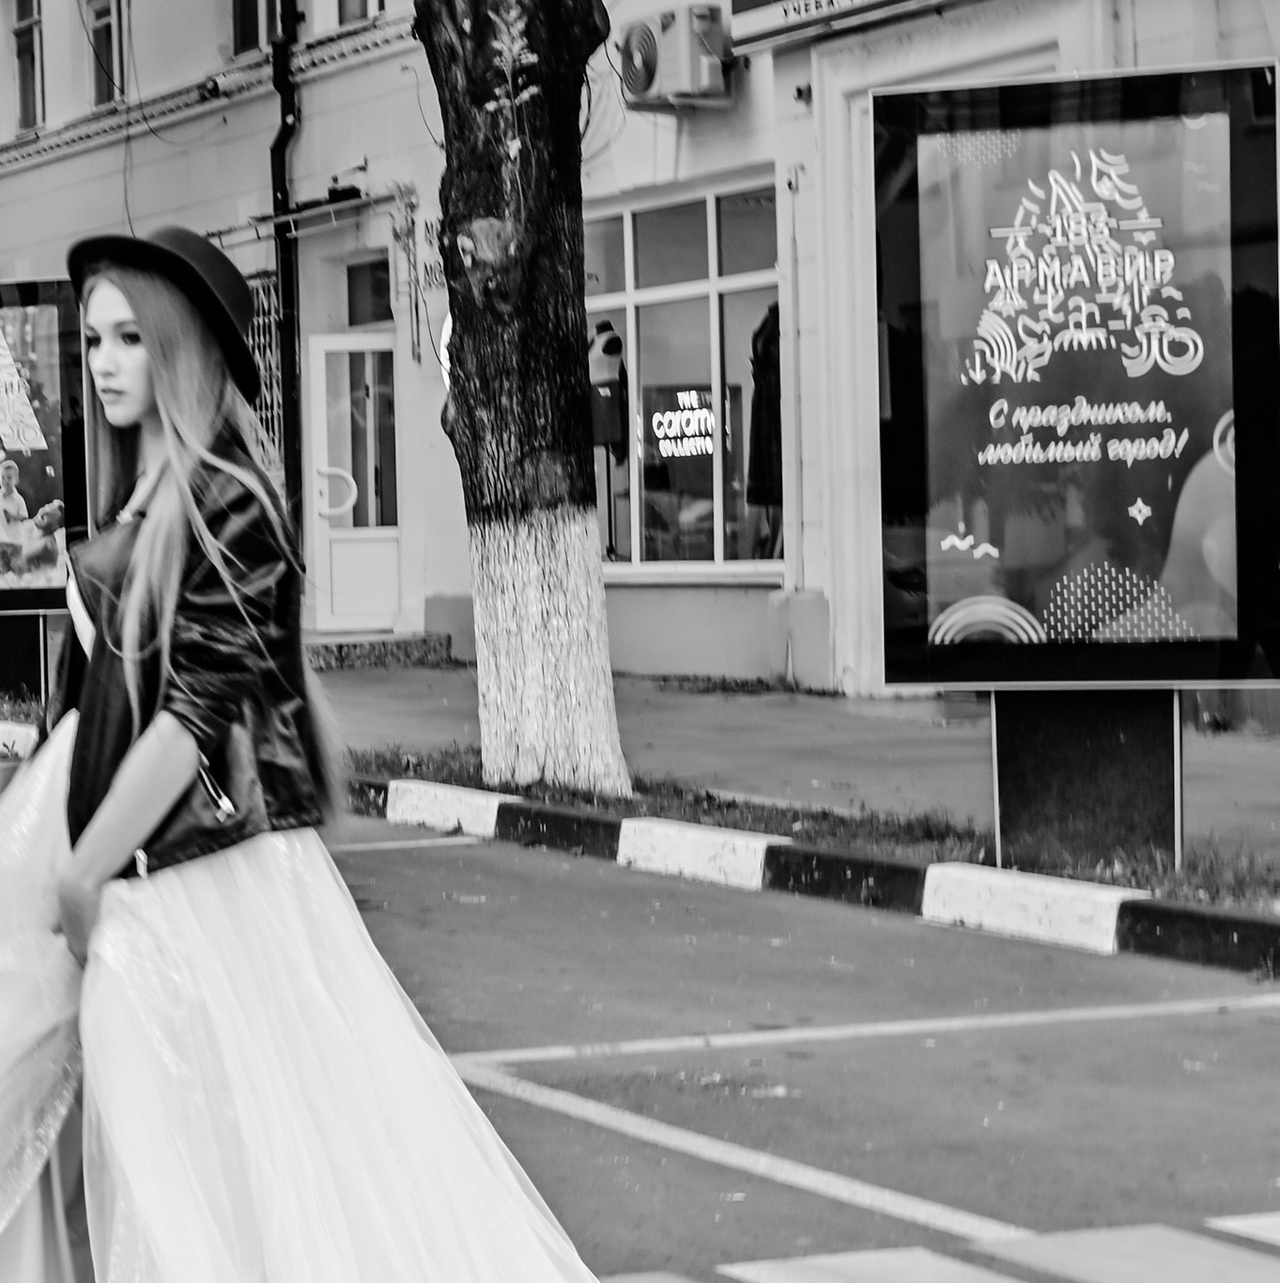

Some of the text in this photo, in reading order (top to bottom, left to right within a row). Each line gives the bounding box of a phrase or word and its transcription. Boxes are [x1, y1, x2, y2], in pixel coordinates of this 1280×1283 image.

[985, 249, 1175, 293] АРМАВИР
[677, 390, 699, 409] THE
[989, 398, 1008, 428] С
[978, 427, 1190, 469] любимый город!
